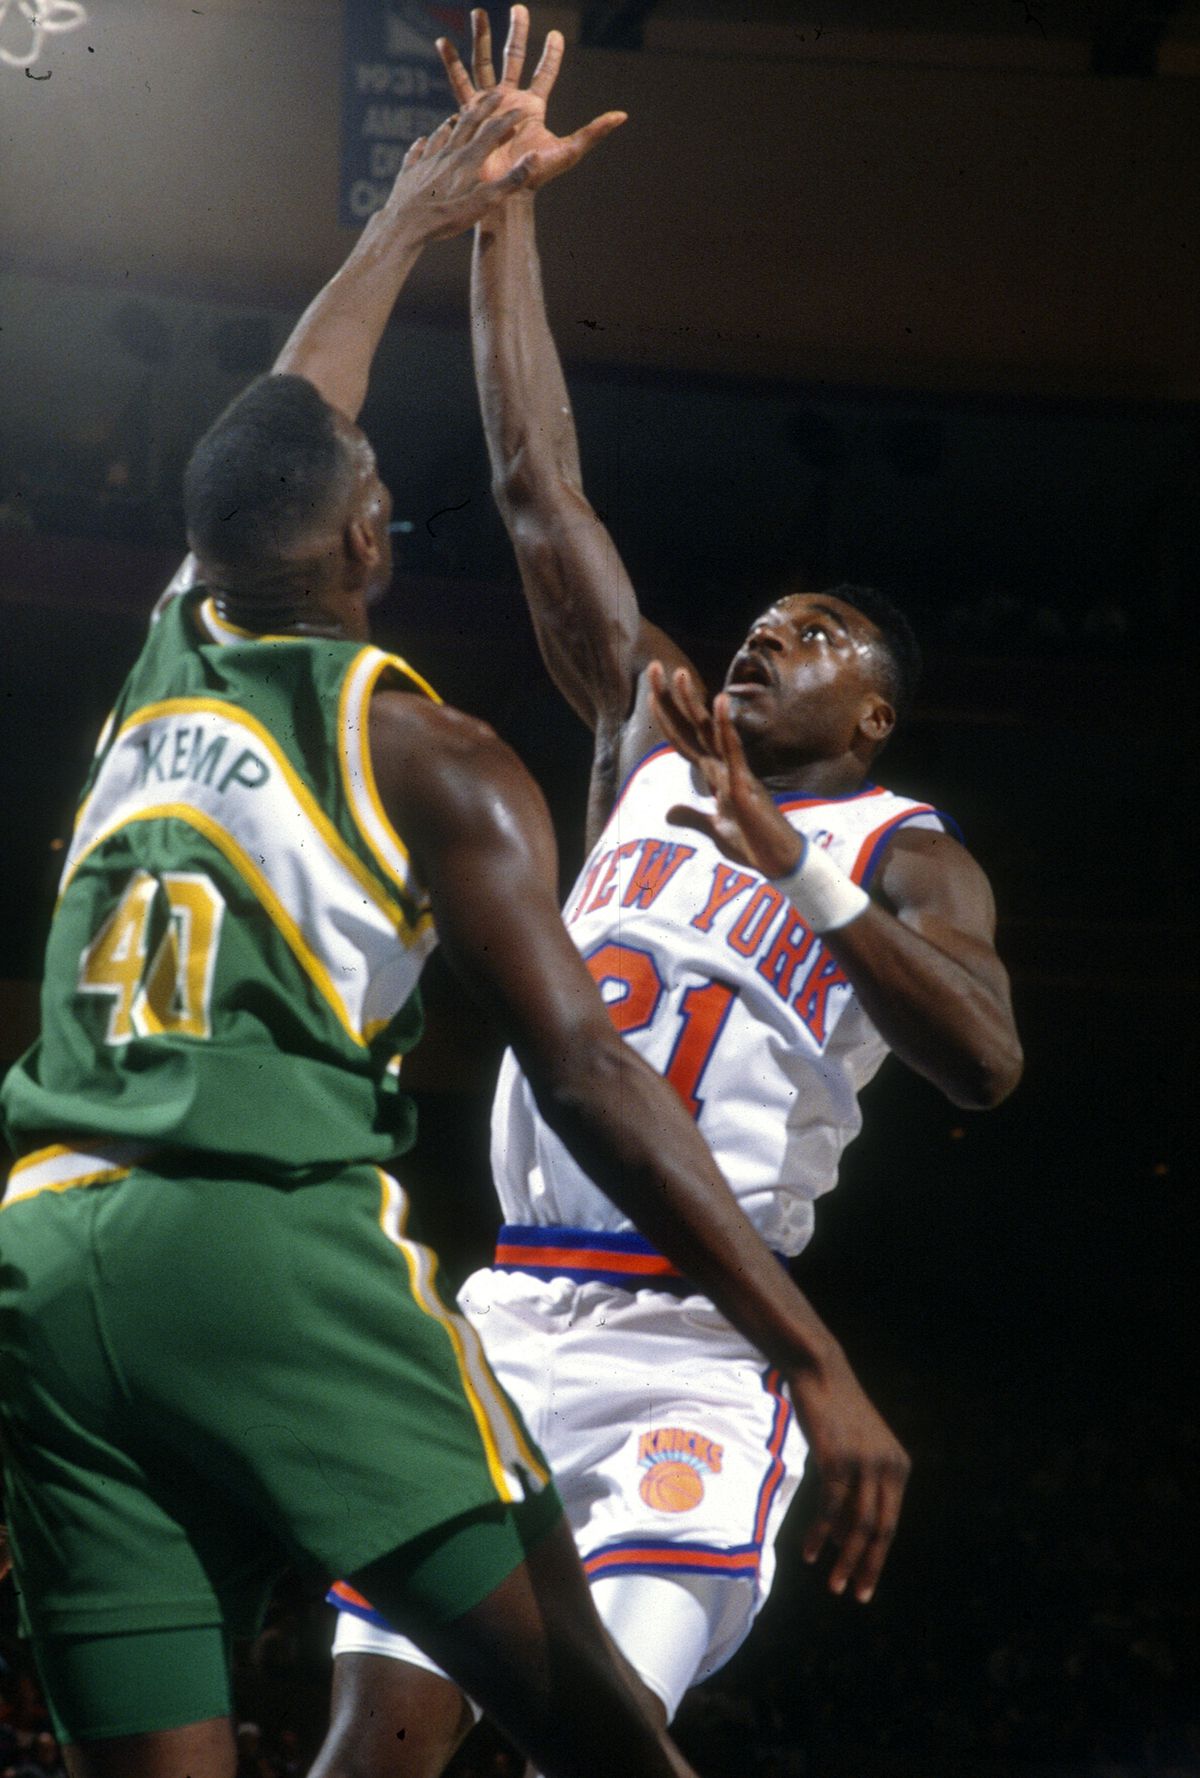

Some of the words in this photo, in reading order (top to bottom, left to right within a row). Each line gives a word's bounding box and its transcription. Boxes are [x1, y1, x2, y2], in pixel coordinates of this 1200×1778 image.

[141, 726, 270, 794] KEMP
[77, 869, 226, 1045] 40
[690, 862, 853, 1048] YORK
[637, 1427, 725, 1474] KNICKS
